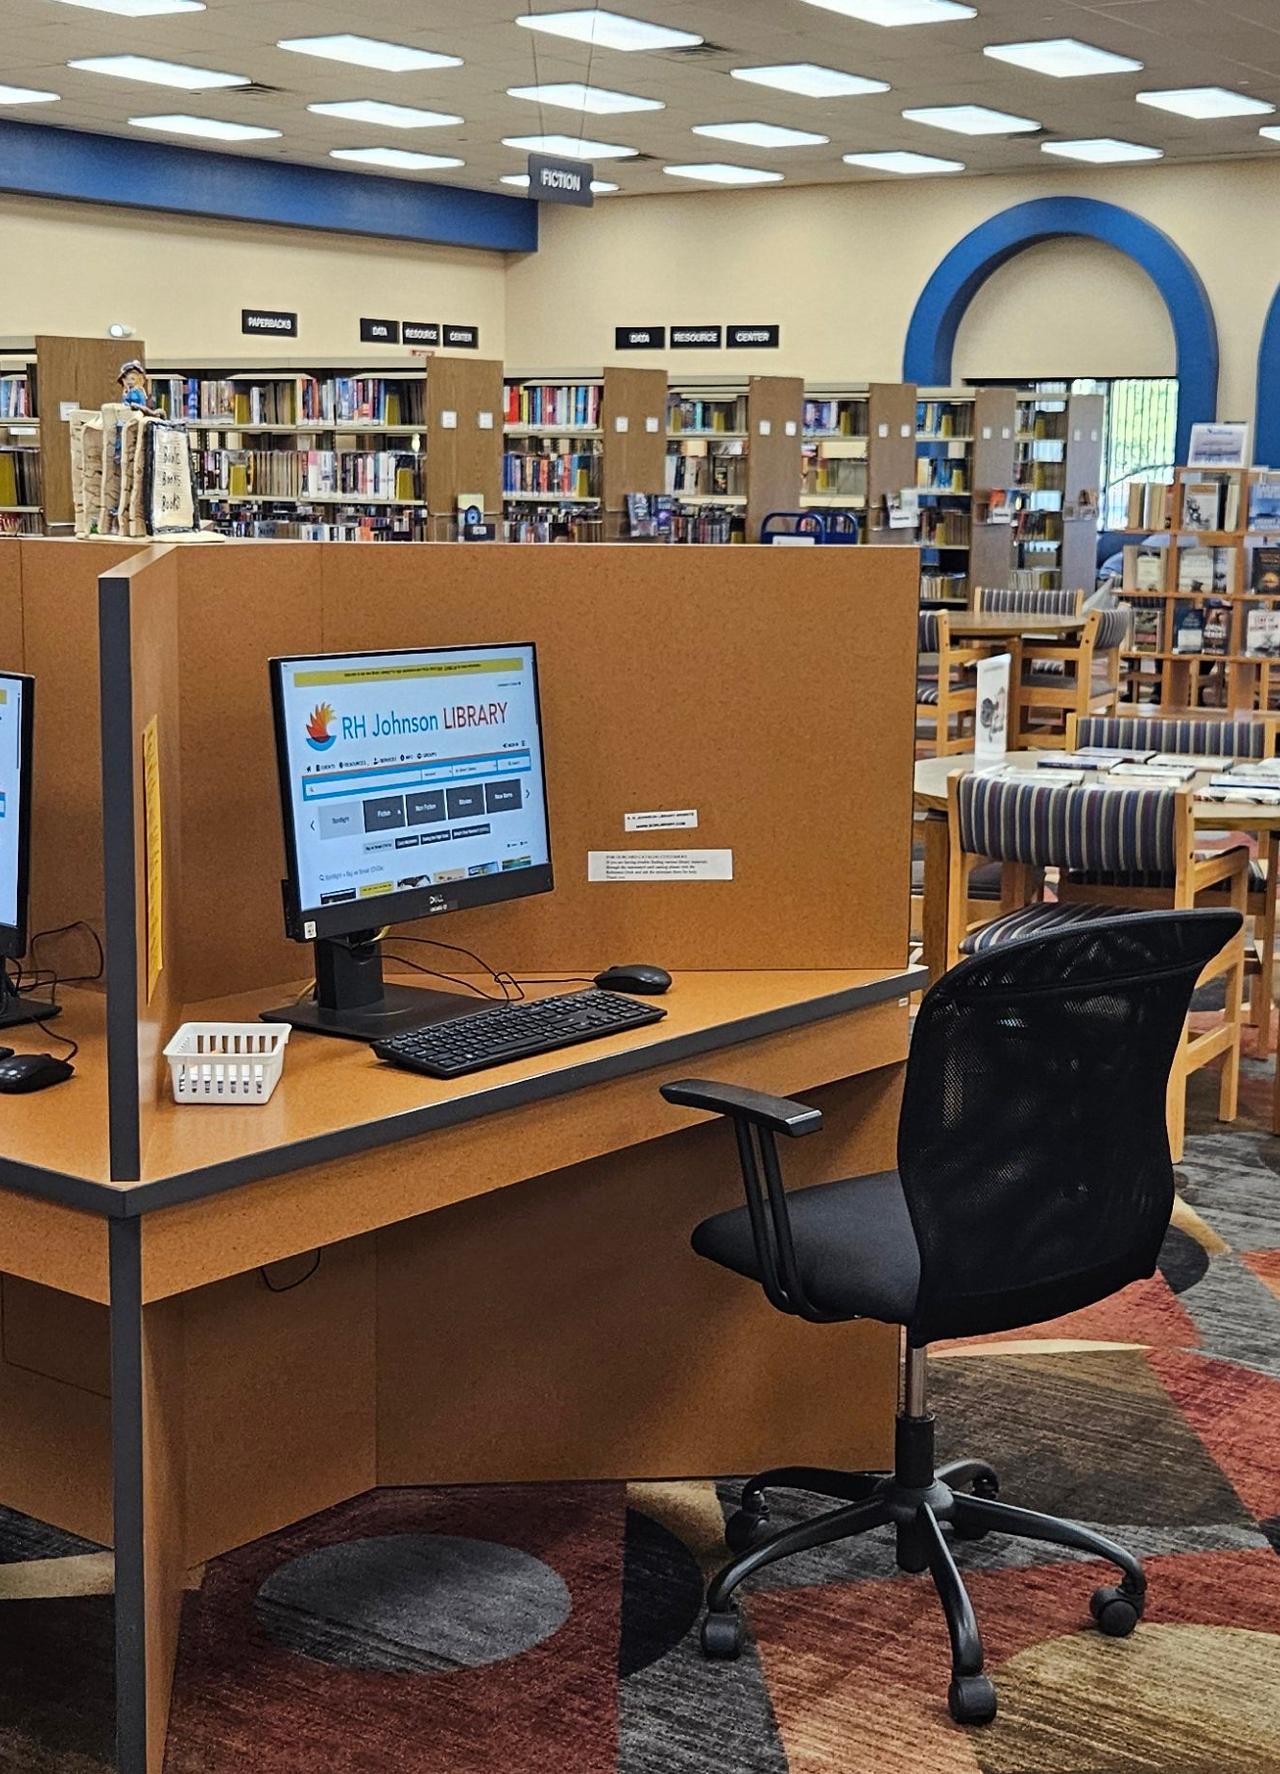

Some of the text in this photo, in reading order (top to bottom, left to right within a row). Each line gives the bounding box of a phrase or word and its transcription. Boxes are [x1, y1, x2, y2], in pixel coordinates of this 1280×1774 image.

[541, 167, 581, 191] FICTION
[248, 316, 292, 330] PAPERBACKS
[372, 326, 473, 343] DATA RESOURCE CENTER
[628, 330, 770, 344] DATA RESOURCE CENTER
[342, 702, 508, 740] RH Johnson LIBRARY
